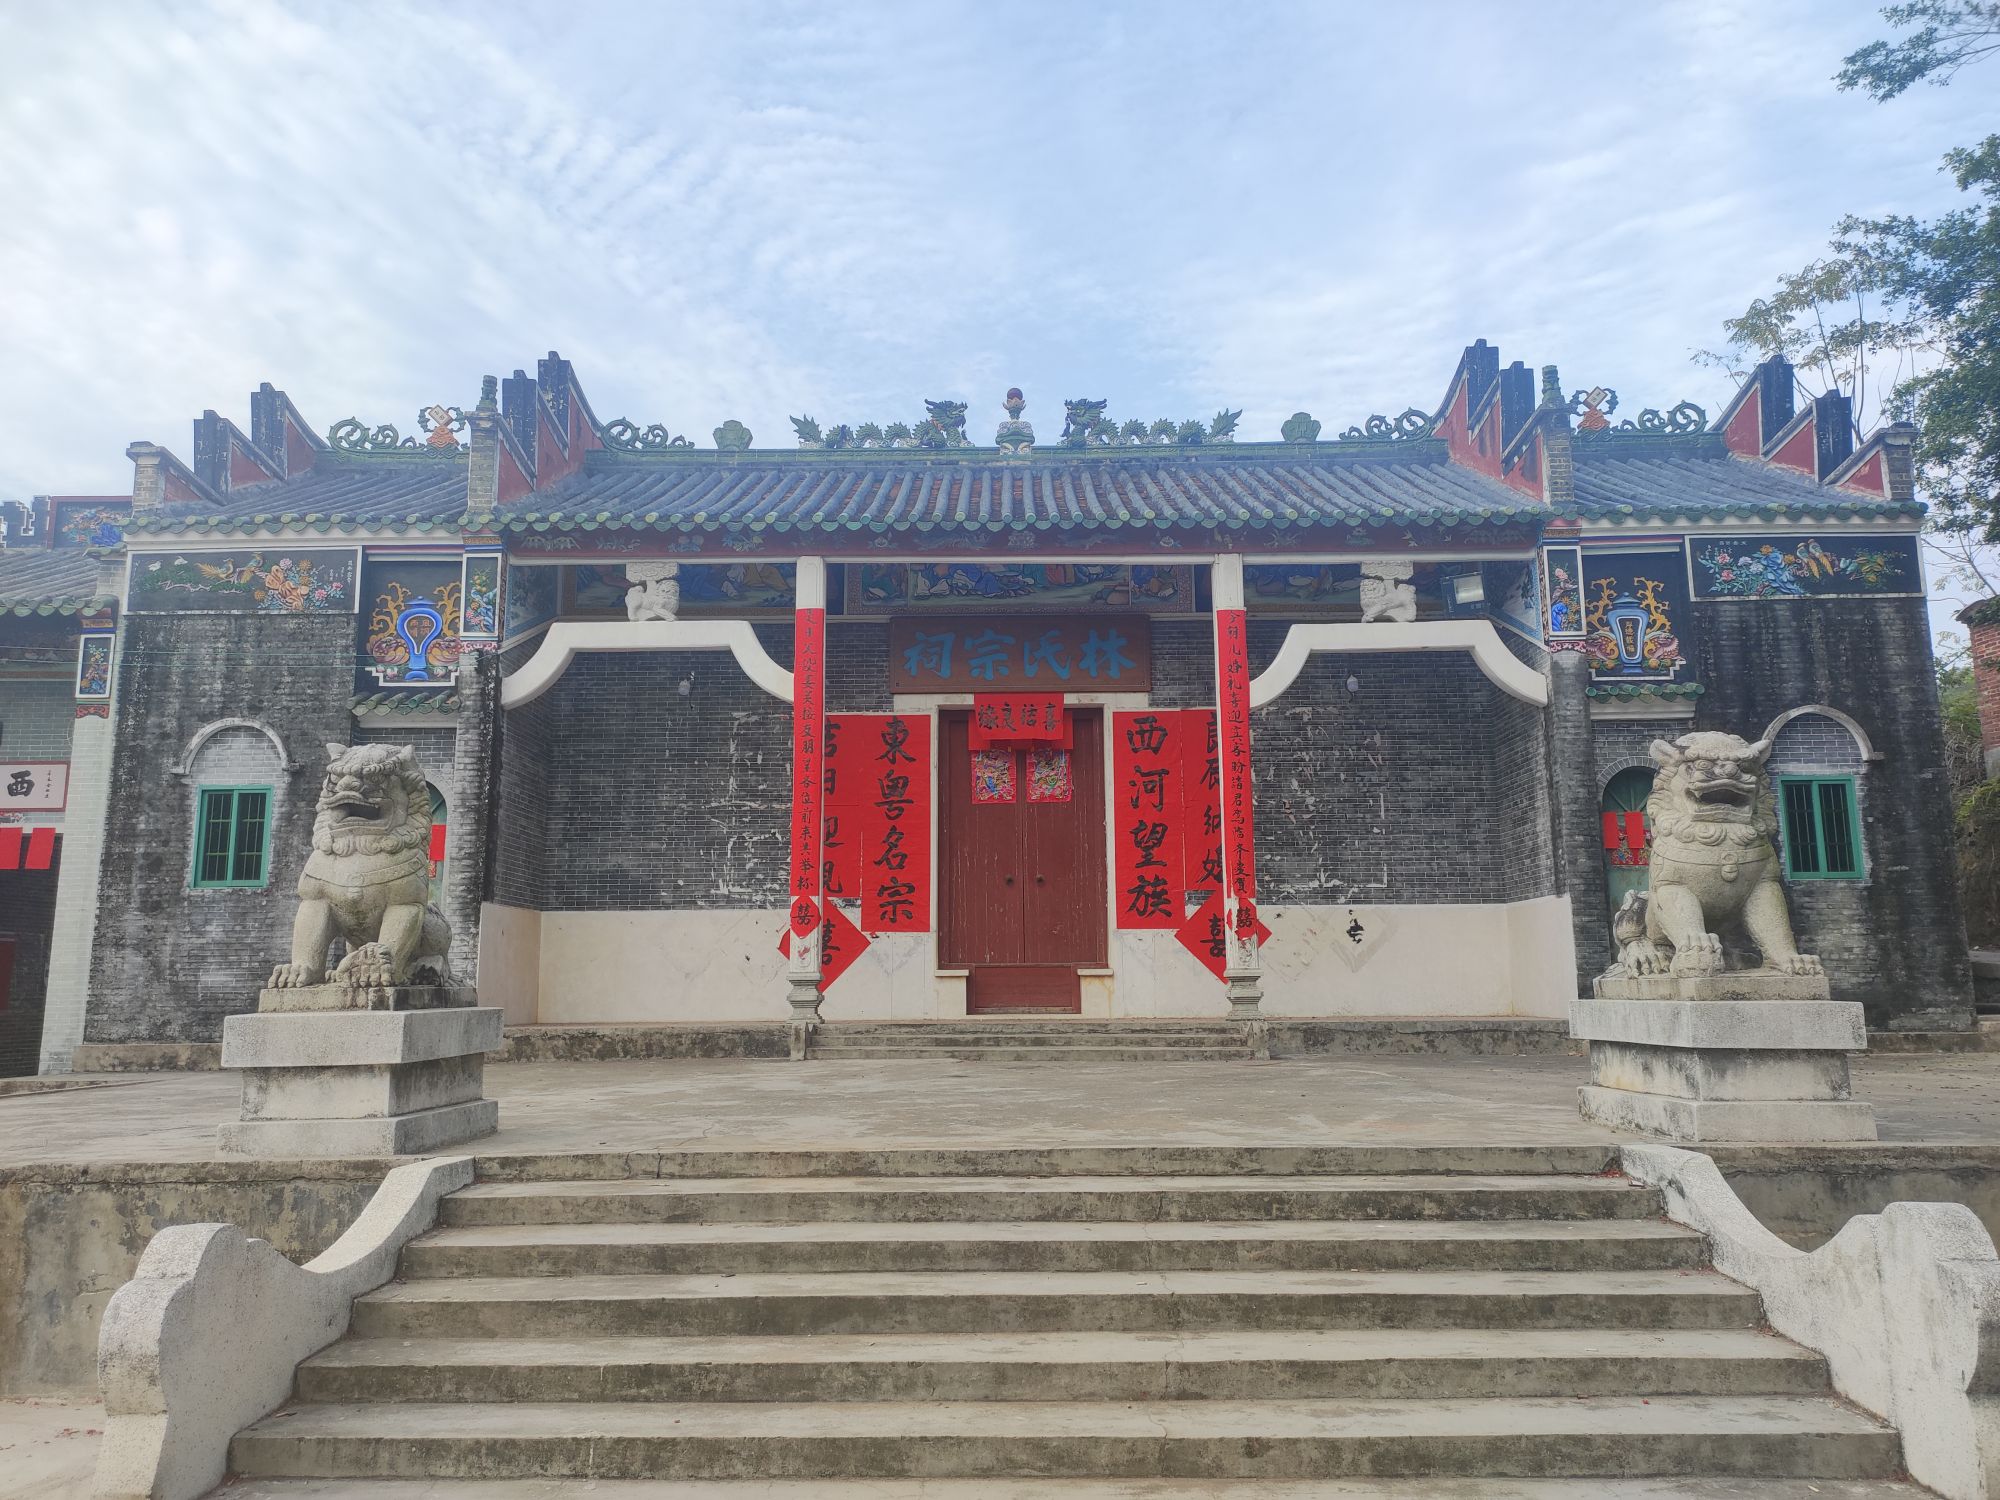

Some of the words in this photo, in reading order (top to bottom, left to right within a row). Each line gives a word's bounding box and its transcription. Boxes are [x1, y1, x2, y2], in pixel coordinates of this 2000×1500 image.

[903, 629, 1136, 681] 林氏宗祠
[7, 769, 36, 797] 西
[1126, 715, 1173, 918] 西河望族
